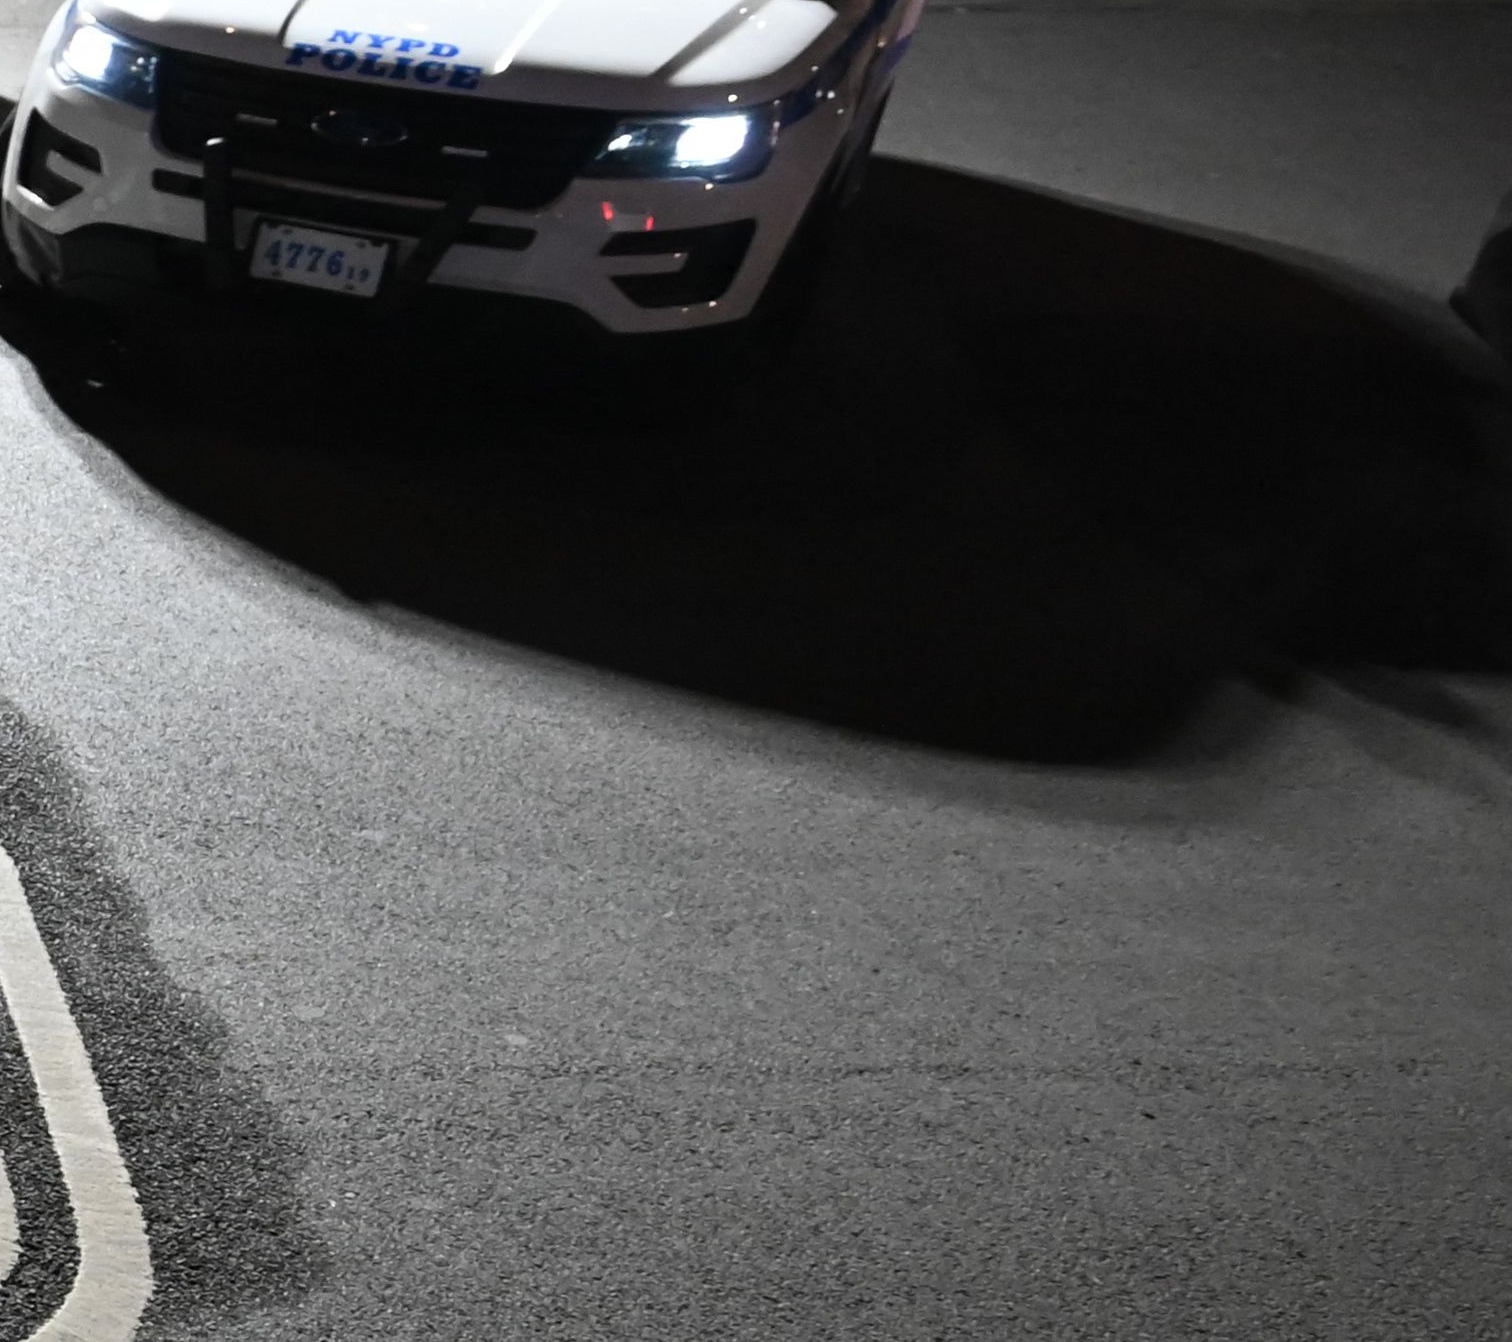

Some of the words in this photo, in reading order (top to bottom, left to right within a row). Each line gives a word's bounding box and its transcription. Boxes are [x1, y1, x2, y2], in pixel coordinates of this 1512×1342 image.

[328, 29, 460, 58] NYPD
[285, 42, 484, 90] POLICE
[264, 239, 346, 277] 4776
